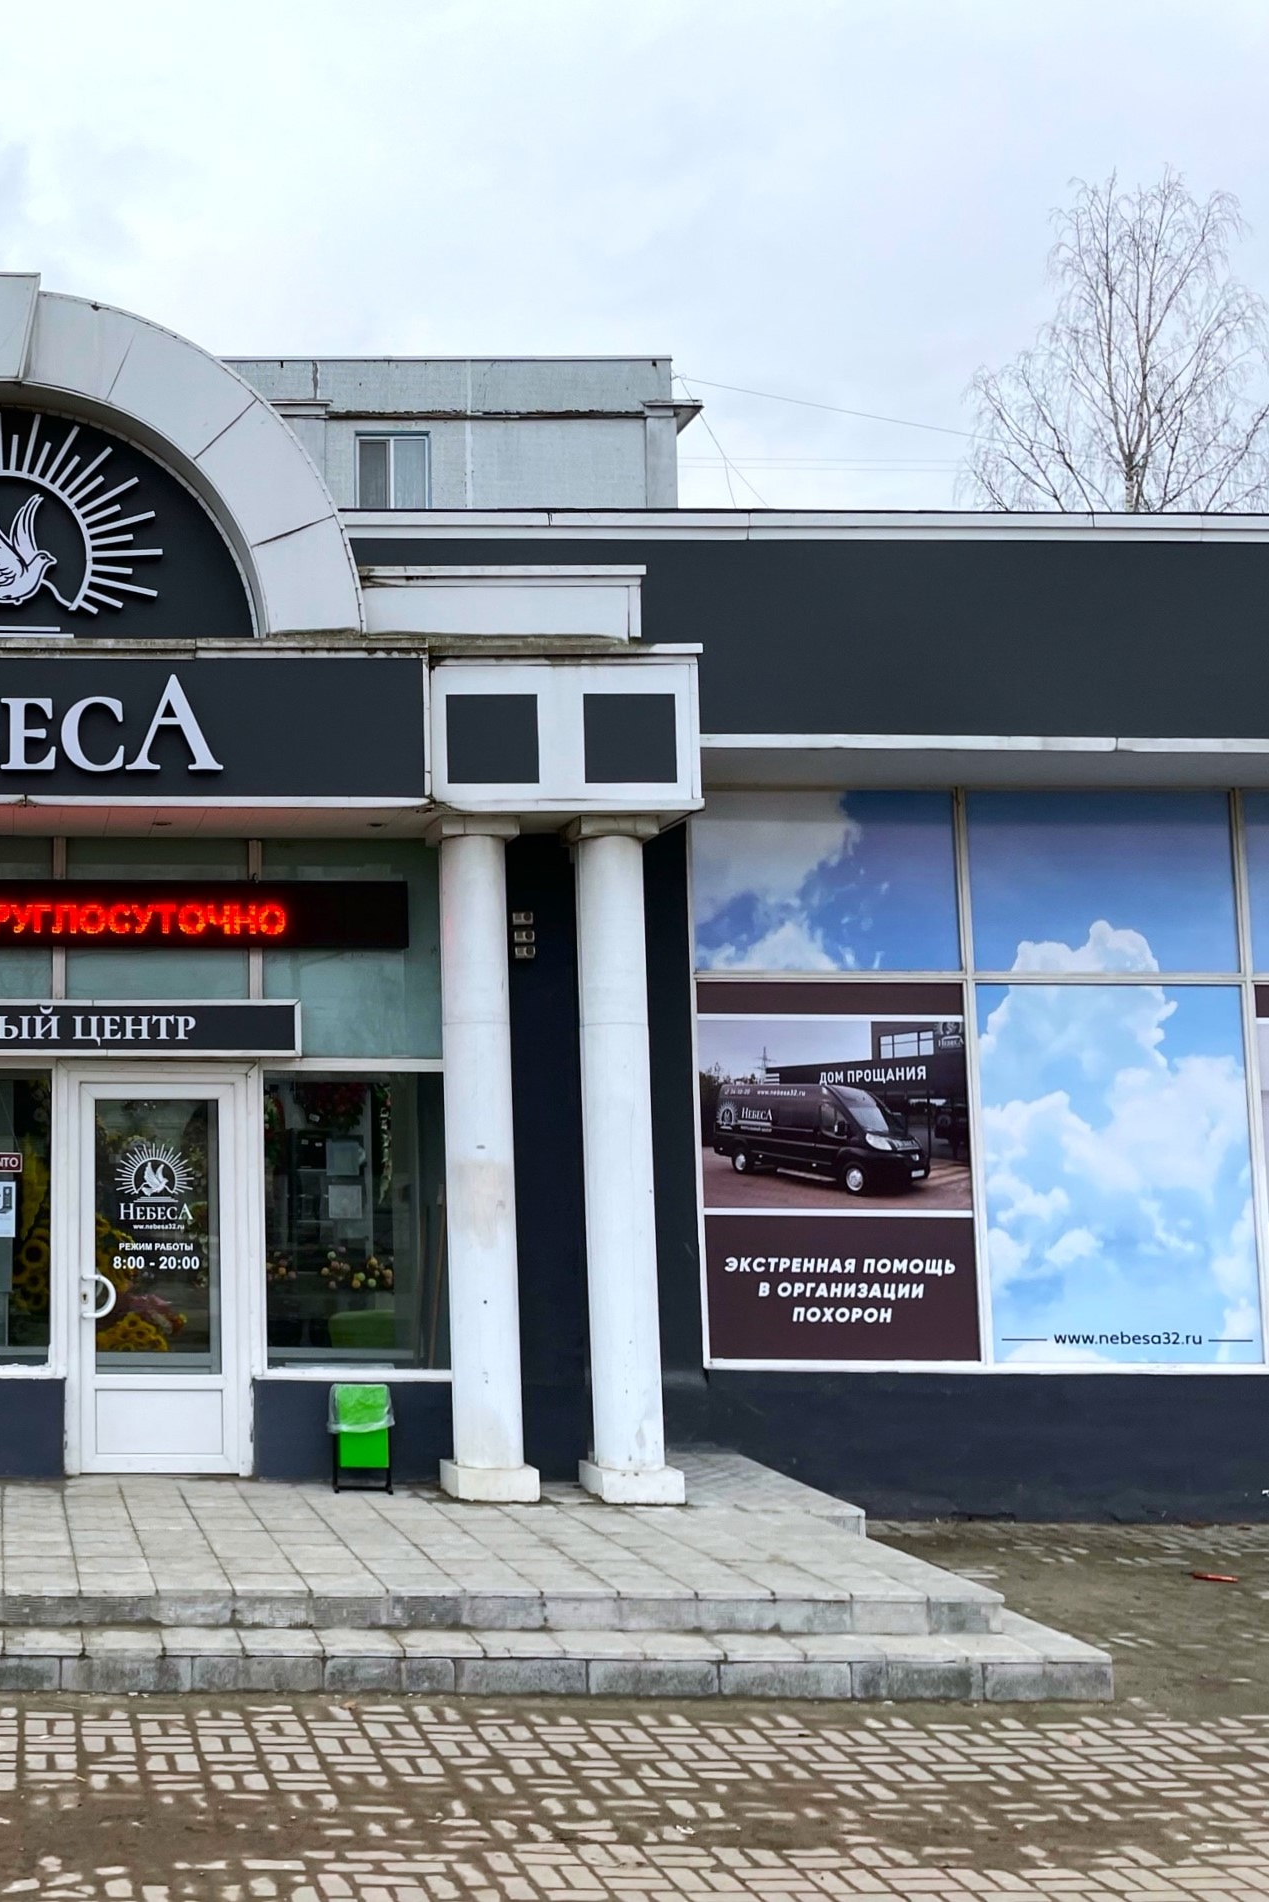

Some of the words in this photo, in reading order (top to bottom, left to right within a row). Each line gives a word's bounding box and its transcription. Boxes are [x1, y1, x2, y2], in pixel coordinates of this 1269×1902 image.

[72, 1014, 196, 1046] ЦЕНТР
[819, 1070, 844, 1086] ДОМ
[847, 1066, 927, 1084] ПРОЩАНИЯ
[118, 1242, 153, 1251] РЕЖИМ
[154, 1242, 194, 1251] РАБОТЫ
[113, 1256, 145, 1270] 8:00
[159, 1256, 200, 1270] 20:00
[724, 1257, 857, 1274] ЭКСТРЕННАЯ
[862, 1258, 957, 1277] ПОМОЩЬ
[758, 1282, 771, 1297] В
[777, 1282, 925, 1301] ОРГАНИЗАЦИИ
[792, 1306, 893, 1323] ПОХОРОН
[1054, 1331, 1203, 1345] www.nebesa32.ru
